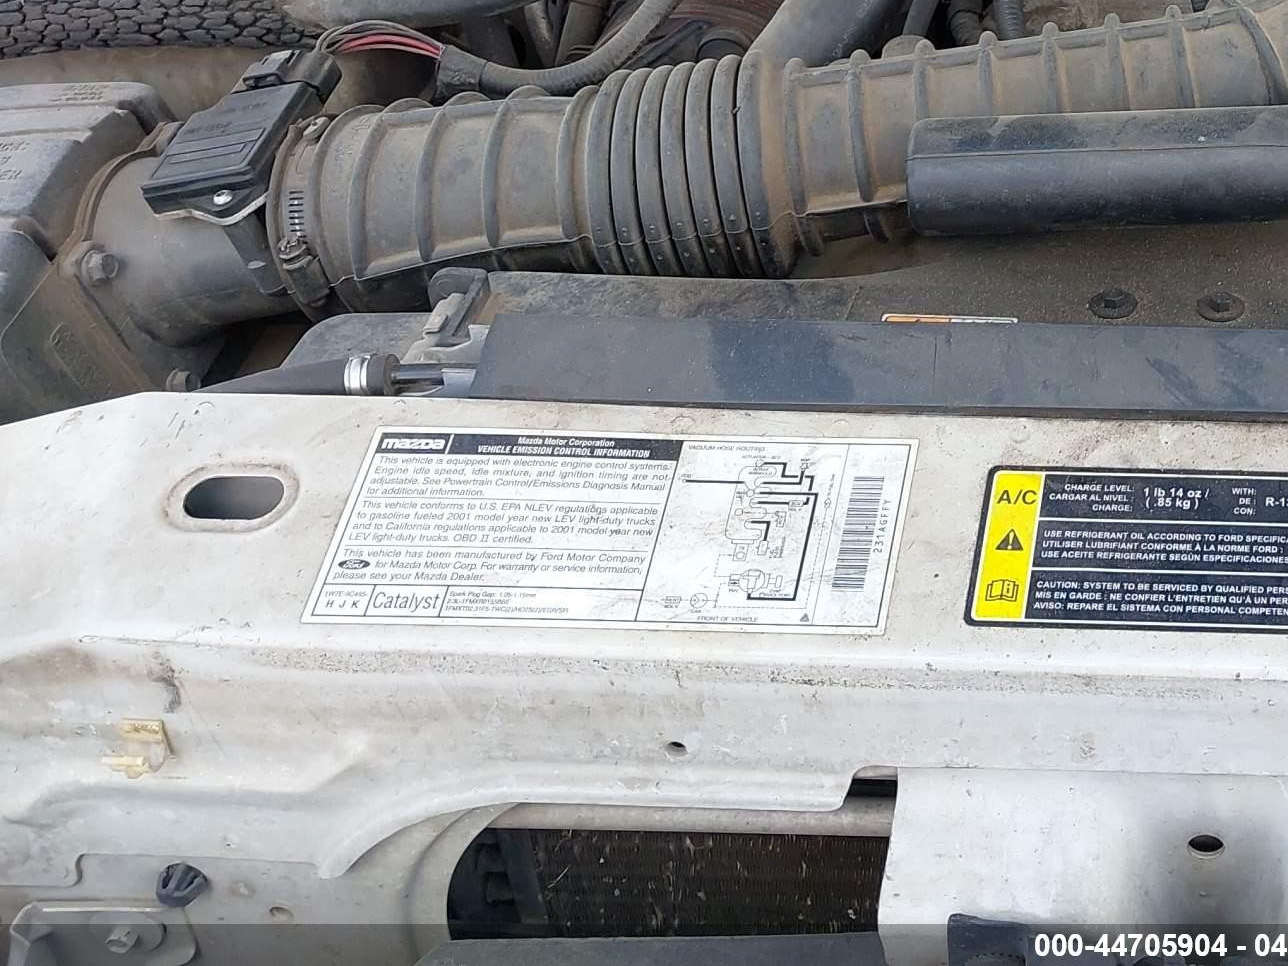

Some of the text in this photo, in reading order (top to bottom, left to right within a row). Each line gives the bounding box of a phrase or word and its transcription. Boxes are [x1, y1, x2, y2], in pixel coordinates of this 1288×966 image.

[516, 437, 543, 445] Mazda
[567, 438, 616, 448] Corporation
[475, 445, 651, 457] VEHICLE EMISSION CONTROL INFORMATION
[400, 456, 434, 464] vehicle
[434, 457, 444, 465] is
[444, 457, 490, 468] equipped
[491, 458, 511, 466] with
[512, 459, 558, 467] electronic
[559, 460, 593, 470] engine
[594, 461, 627, 469] control
[372, 466, 409, 476] Engine
[470, 468, 489, 476] idle
[535, 469, 555, 477] and
[557, 470, 595, 480] ignition
[597, 471, 629, 481] timing
[651, 472, 669, 480] not
[368, 476, 666, 491] adjustable. See Powertrain Control/Emissions Diagnosis Manual
[1064, 483, 1135, 492] CHARGE LEVEL:
[365, 486, 486, 496] for additional information.
[996, 489, 1038, 505] A/C
[1048, 492, 1087, 501] CARGAR
[1103, 494, 1127, 502] NIVEL
[1142, 487, 1148, 496] 1
[1153, 487, 1165, 497] lb
[1170, 488, 1183, 497] 14
[1091, 503, 1133, 512] CHARGE:
[1175, 498, 1190, 509] kg
[1233, 507, 1255, 515] CON:
[1043, 529, 1062, 537] USE
[1064, 530, 1127, 539] REFRIGERANT
[1130, 532, 1144, 540] OIL
[1147, 532, 1201, 542] ACCORDING
[1204, 534, 1215, 542] TO
[1218, 534, 1243, 543] FORD
[1042, 540, 1082, 548] UTILISER
[1085, 541, 1137, 550] LUBRIFIANT
[1140, 543, 1191, 551] CONFORME
[1203, 544, 1214, 552] LA
[1217, 545, 1249, 553] NORME
[1252, 546, 1277, 554] FORD
[1040, 549, 1059, 558] USE
[1061, 550, 1094, 559] ACEITE
[1096, 551, 1166, 561] REFRIGERANTE
[1202, 554, 1288, 564] ESPECIFICACIONES
[1036, 580, 1080, 589] CAUTION:
[1083, 581, 1120, 590] SYSTEM
[1123, 583, 1135, 591] TO
[1137, 583, 1149, 591] BE
[1152, 583, 1198, 593] SERVICED
[1200, 585, 1212, 593] BY
[1215, 585, 1263, 595] QUALIFIED
[324, 599, 361, 608] H J K
[369, 591, 442, 614] Catalyst
[1034, 590, 1051, 598] MIS
[1053, 590, 1066, 599] EN
[1068, 591, 1101, 600] GARDE
[1109, 592, 1121, 601] NE
[1124, 593, 1165, 602] CONFIER
[1254, 596, 1266, 605] UN
[1033, 600, 1064, 610] AVISO:
[1066, 601, 1103, 611] REPARE
[1106, 602, 1116, 611] EL
[1120, 603, 1160, 613] SISTEMA
[1162, 604, 1183, 614] CON
[1185, 605, 1233, 615] PERSONAL
